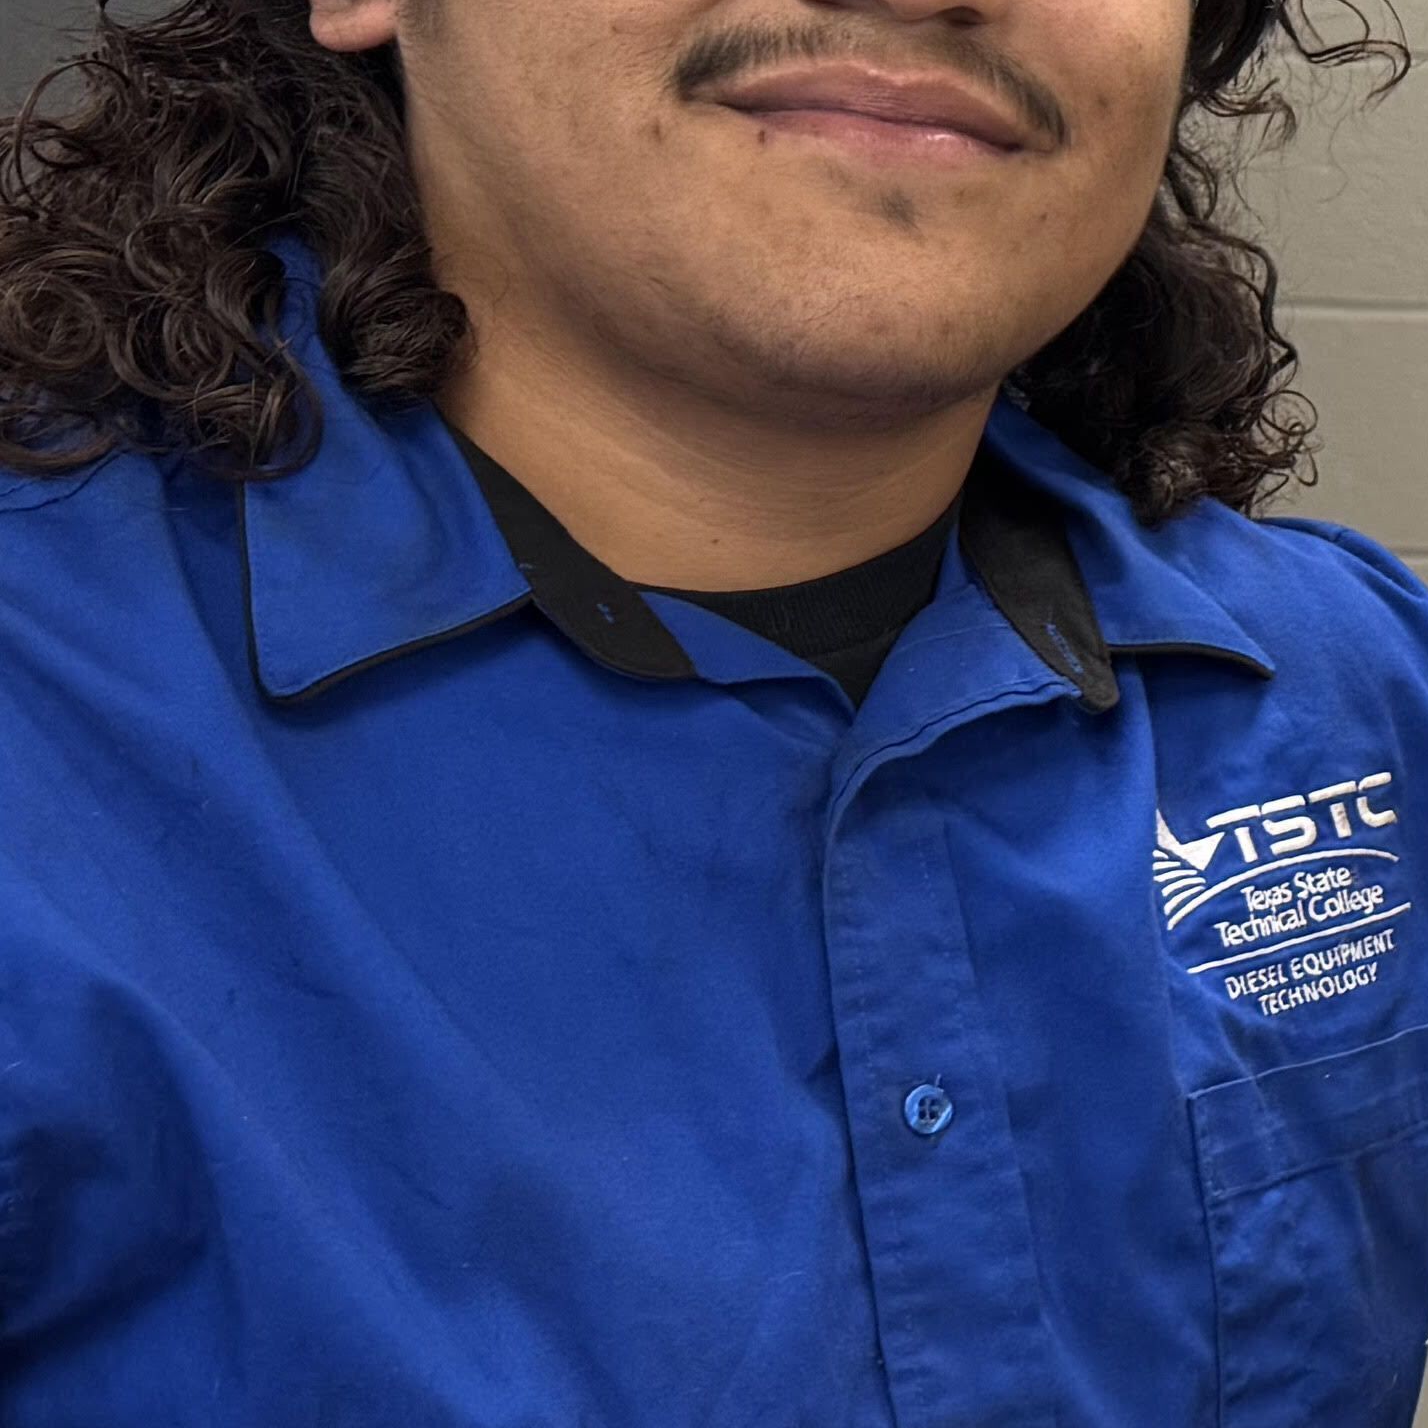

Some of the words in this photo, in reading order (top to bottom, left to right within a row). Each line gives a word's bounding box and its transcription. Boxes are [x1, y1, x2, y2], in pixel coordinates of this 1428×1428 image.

[1206, 772, 1398, 863] TSTC
[1214, 904, 1307, 948] Technical
[1309, 885, 1384, 922] College
[1241, 881, 1292, 915] Texas
[1293, 866, 1351, 900] State
[1224, 963, 1289, 1000] DIESEL
[1291, 928, 1395, 980] EQUIPMENT
[1258, 962, 1379, 1017] TECHNOLOGY
